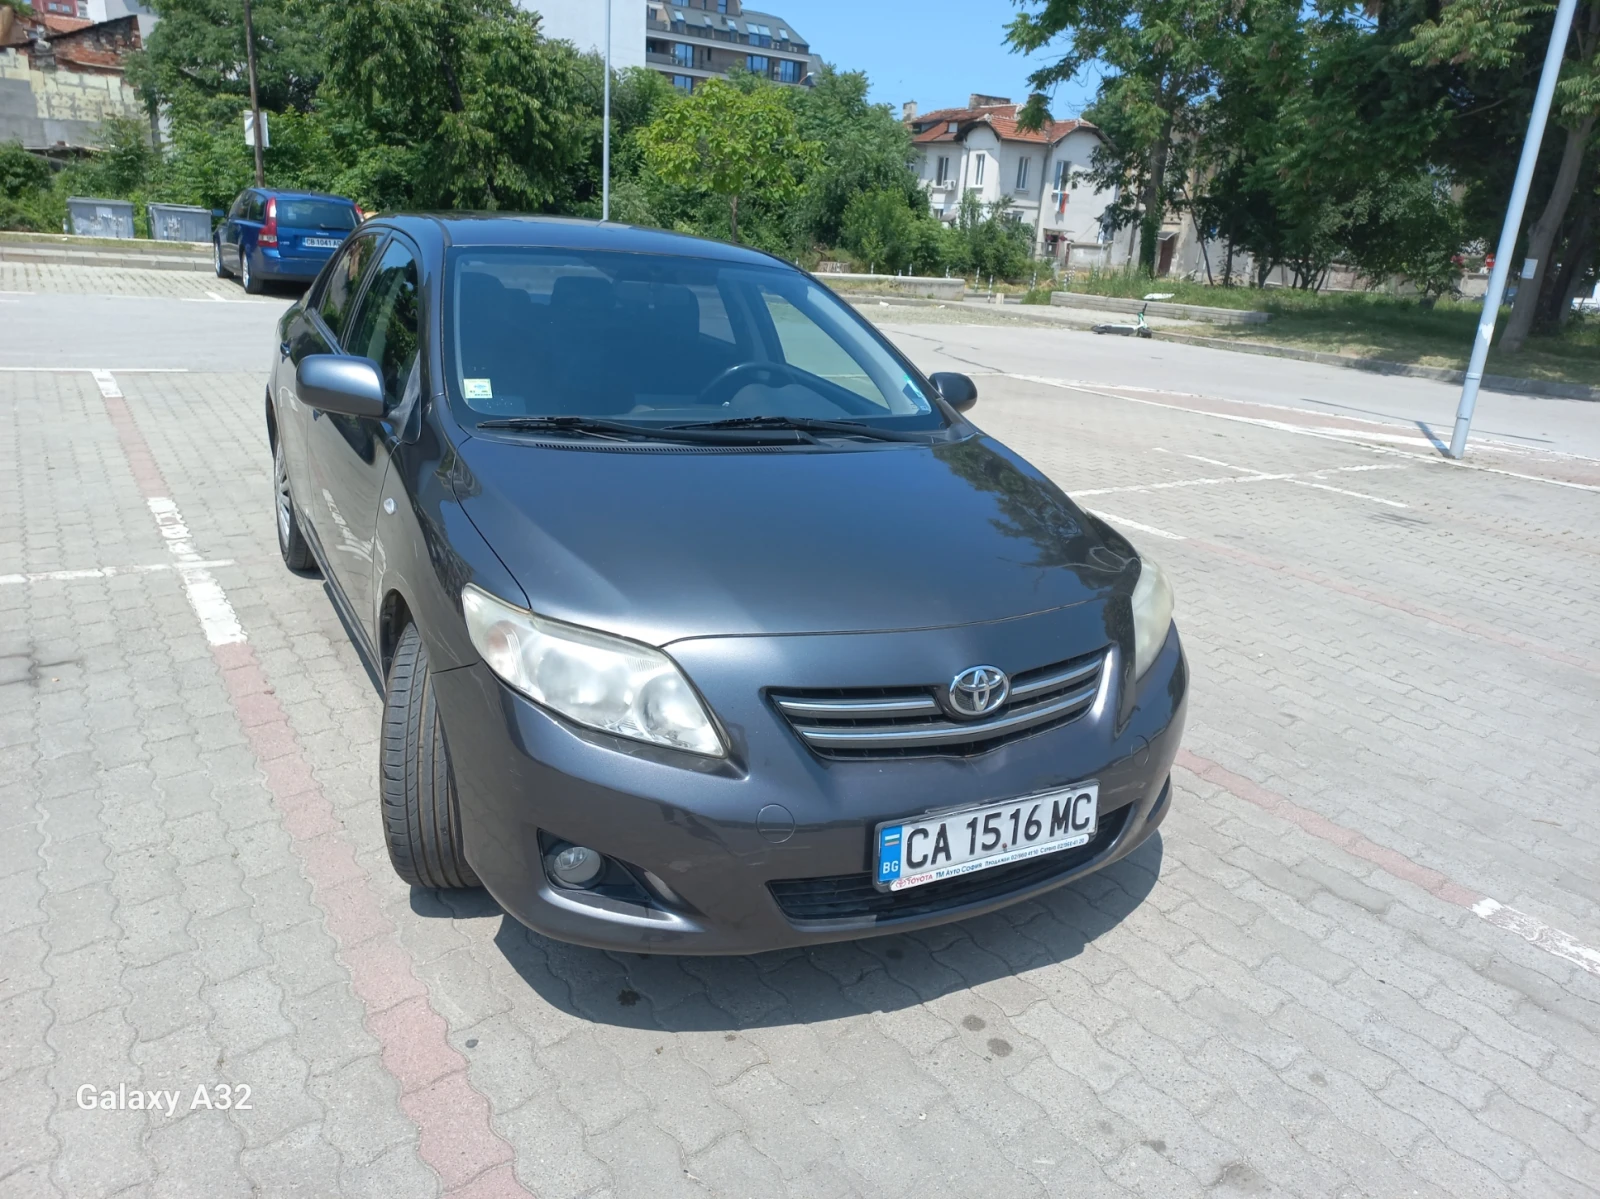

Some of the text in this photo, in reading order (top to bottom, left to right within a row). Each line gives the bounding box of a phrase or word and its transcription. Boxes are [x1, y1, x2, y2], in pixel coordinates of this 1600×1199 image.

[906, 793, 1092, 870] CA 1516 MC
[882, 860, 899, 874] BG
[907, 874, 933, 885] TOYOTA
